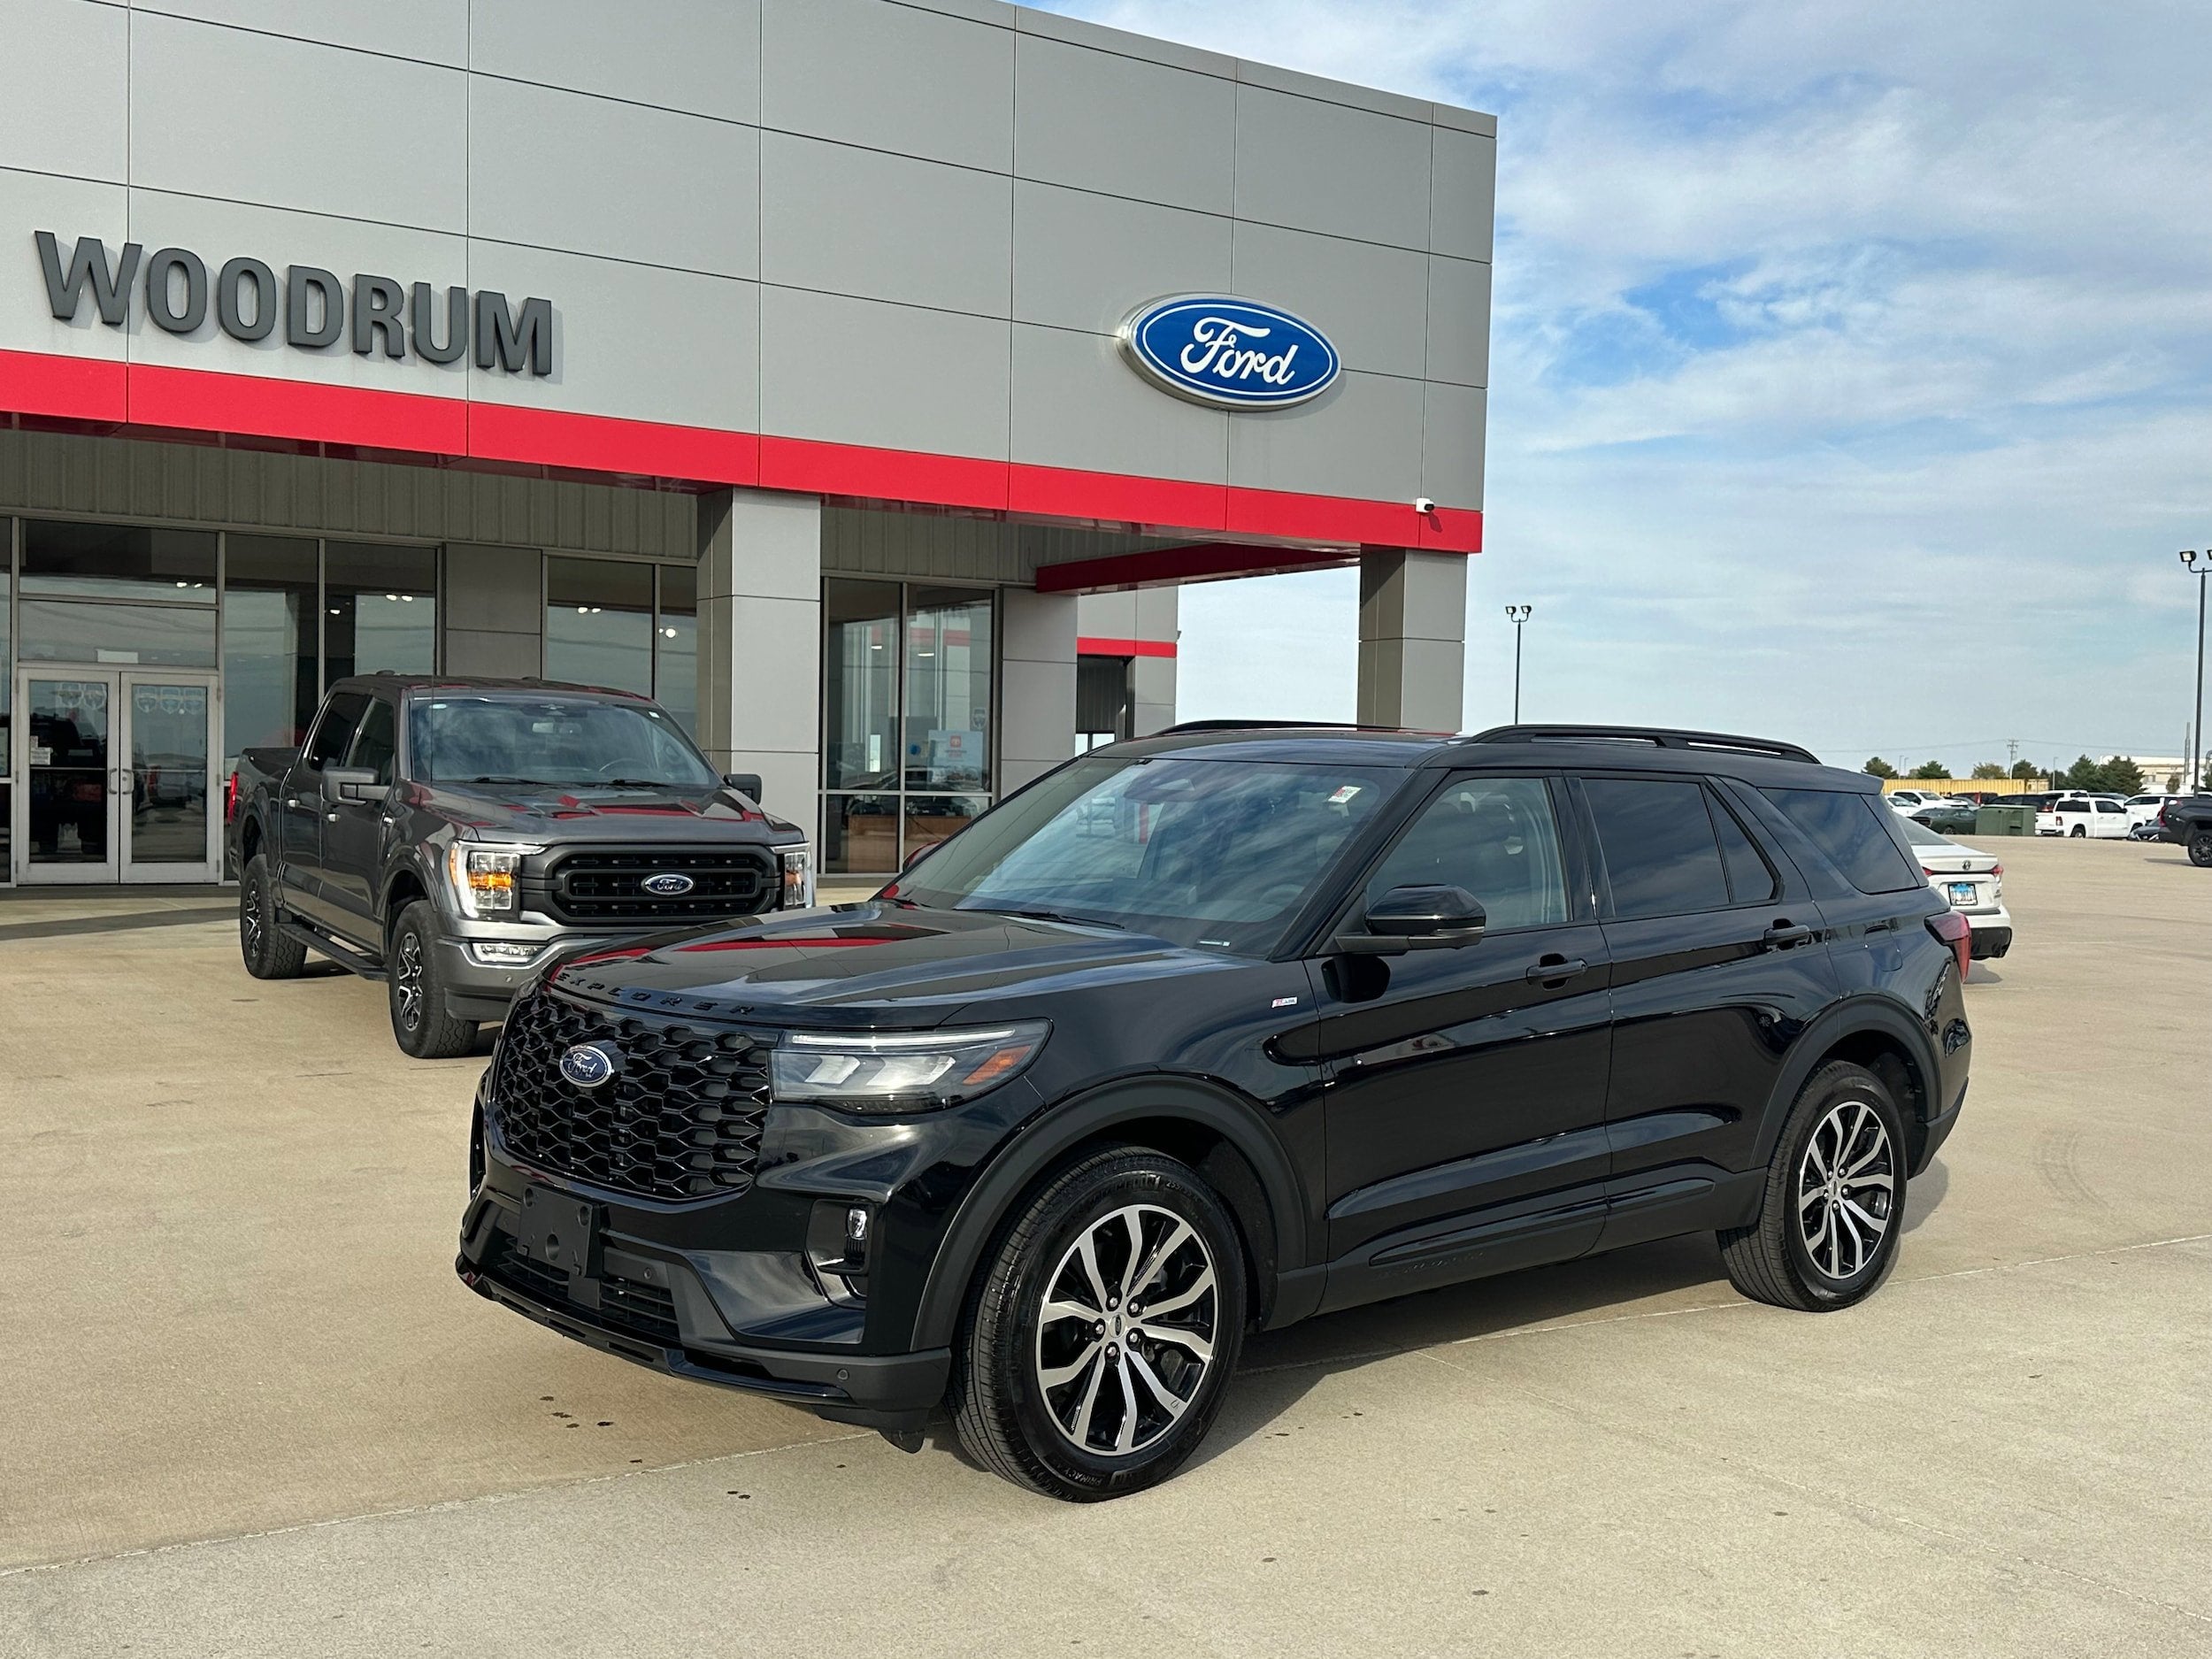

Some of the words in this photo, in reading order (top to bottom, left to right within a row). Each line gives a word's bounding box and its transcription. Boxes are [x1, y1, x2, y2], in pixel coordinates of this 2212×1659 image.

[35, 230, 552, 374] WOODRUM
[1180, 317, 1298, 385] Ford
[657, 879, 684, 890] Ford
[556, 972, 755, 1015] EXPLORER
[567, 1052, 598, 1079] Ford
